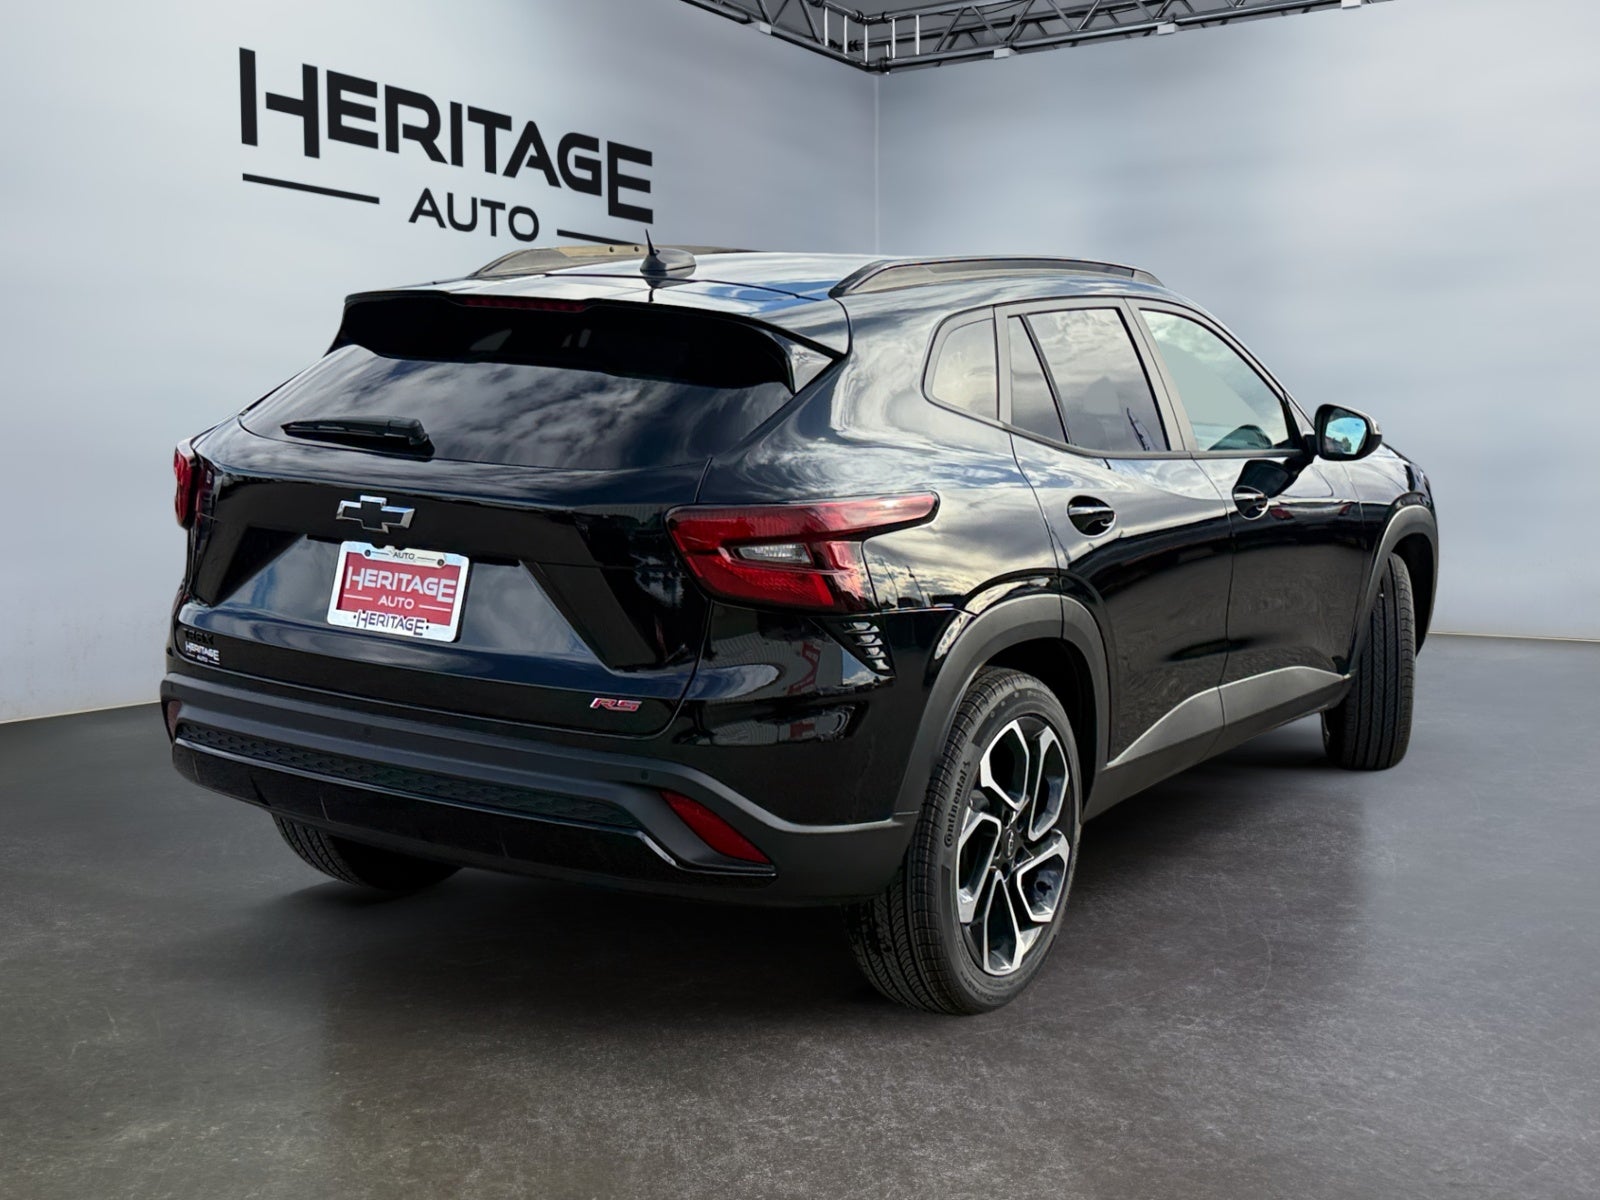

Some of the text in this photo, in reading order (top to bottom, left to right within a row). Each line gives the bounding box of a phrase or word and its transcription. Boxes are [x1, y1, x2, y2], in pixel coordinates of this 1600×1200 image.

[239, 47, 654, 225] HERITAGE
[408, 187, 540, 242] AUTO
[392, 551, 416, 561] AUTO
[345, 566, 457, 604] HERITAGE
[377, 595, 415, 609] AUTO
[356, 611, 425, 636] HERITAGE
[185, 640, 220, 661] HERITAGE
[590, 697, 642, 712] RS
[944, 769, 967, 848] Continental
